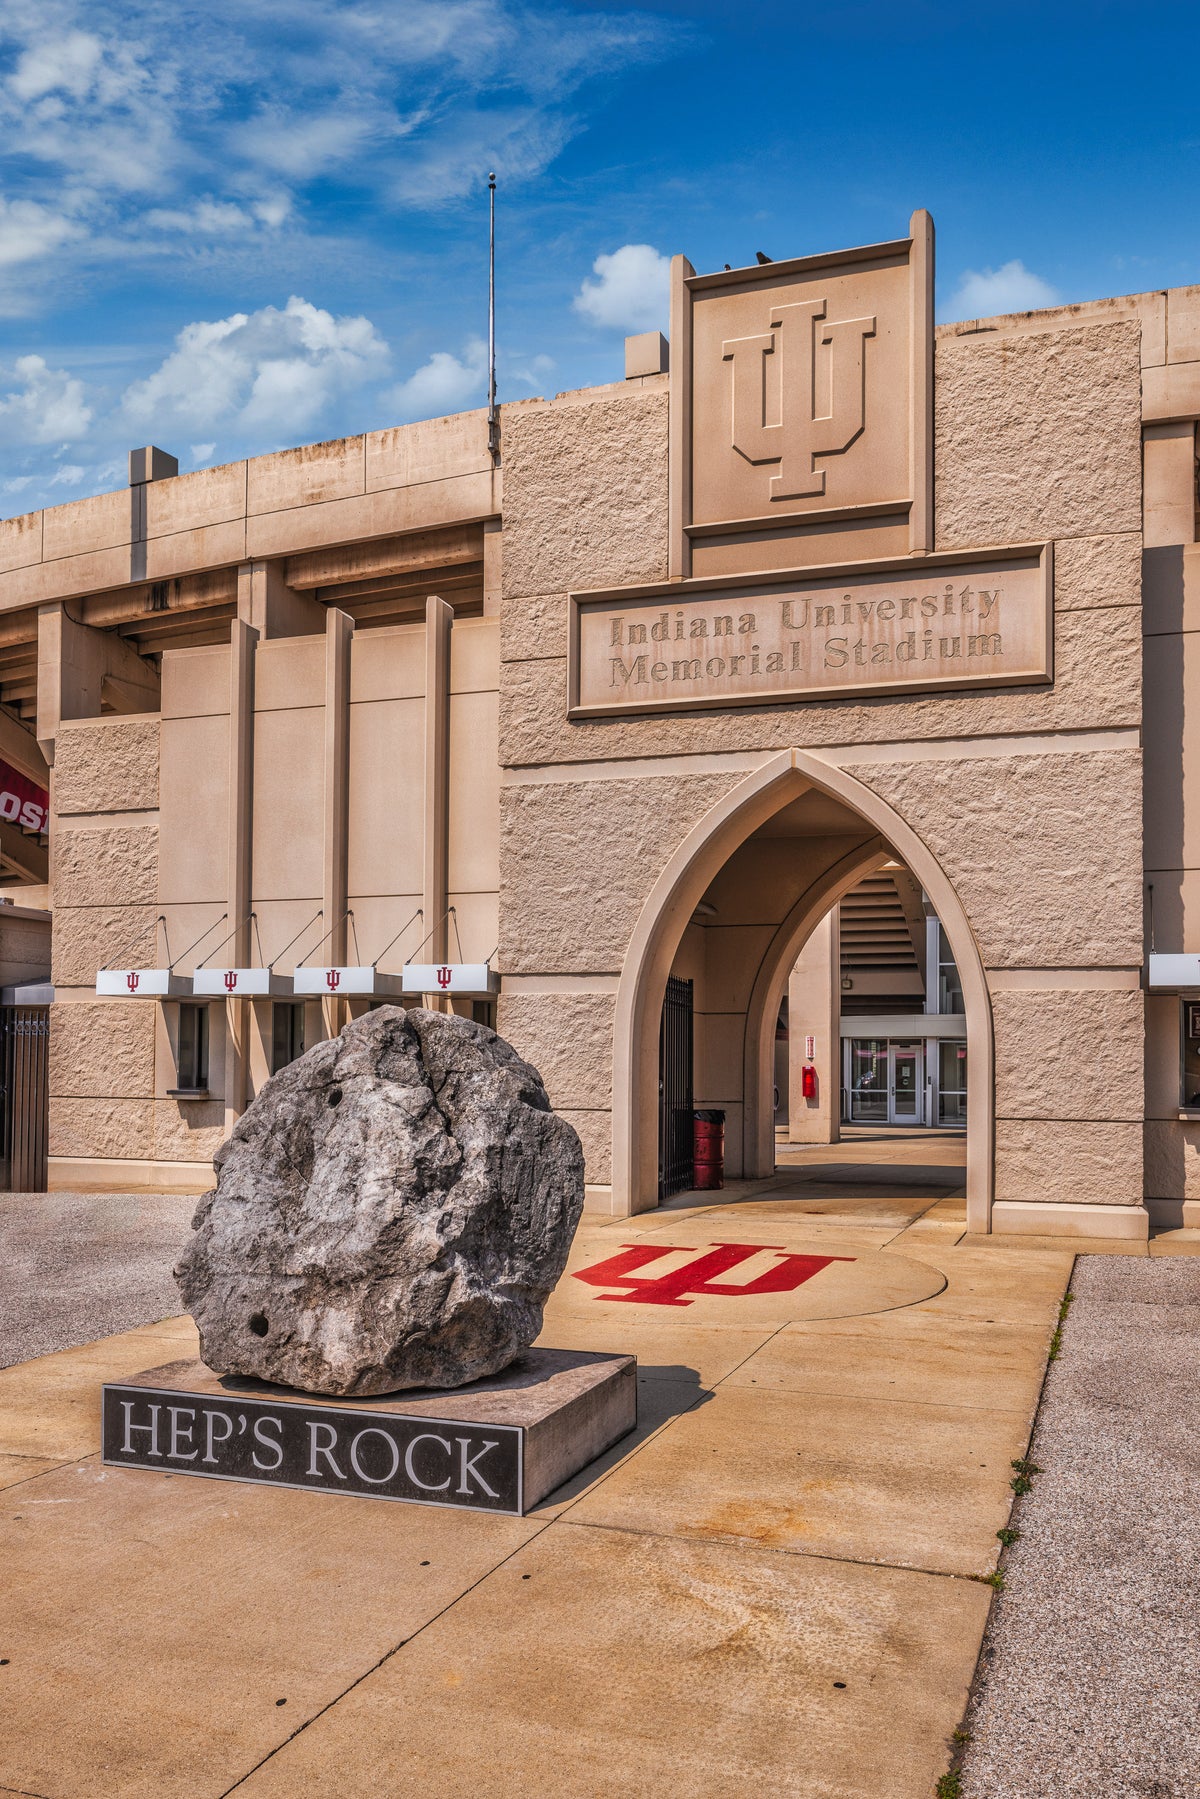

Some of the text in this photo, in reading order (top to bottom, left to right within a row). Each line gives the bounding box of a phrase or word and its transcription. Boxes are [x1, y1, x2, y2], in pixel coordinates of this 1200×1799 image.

[609, 584, 1003, 648] Indiana University
[609, 629, 1003, 688] Memorial Stadium
[120, 1401, 501, 1498] HEP'S ROCK
